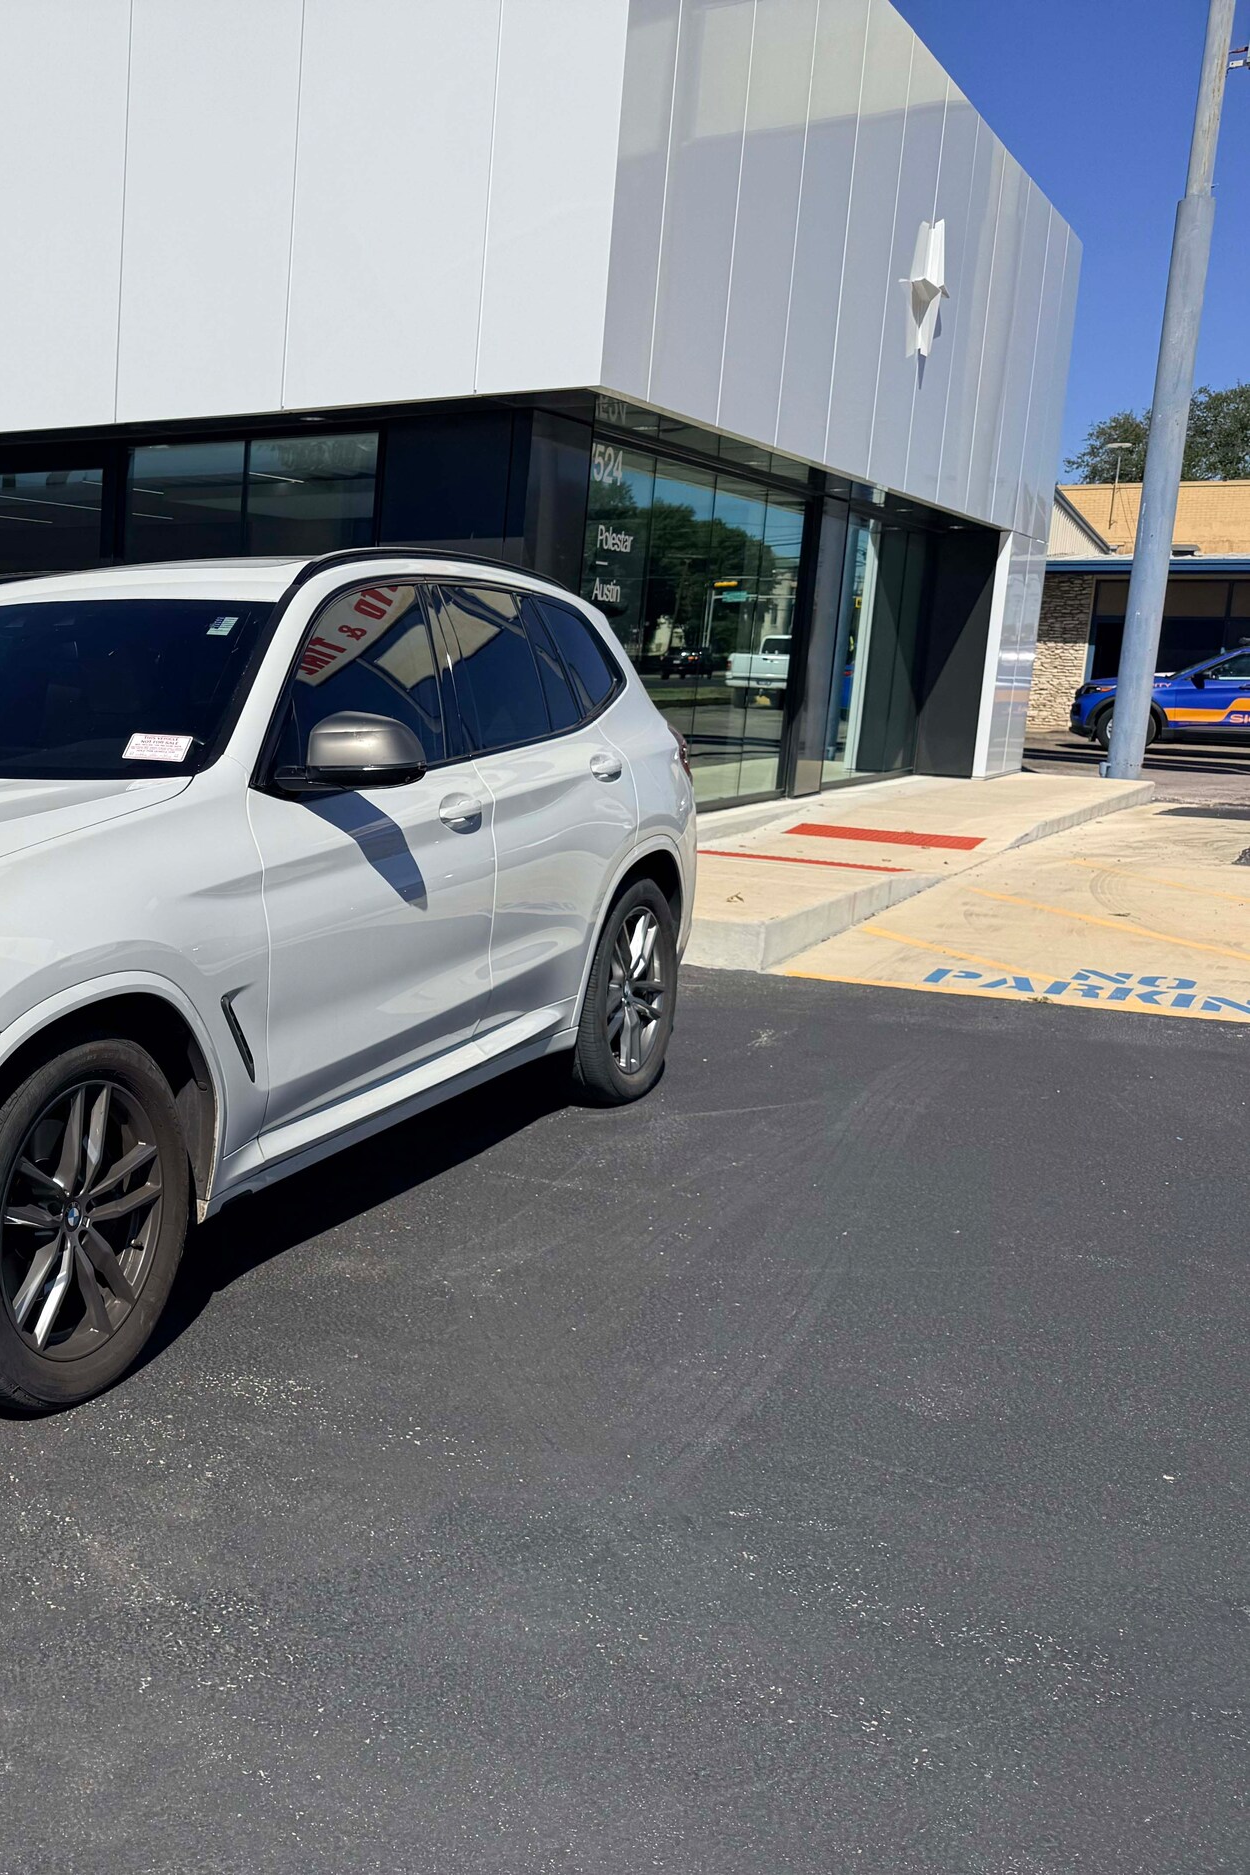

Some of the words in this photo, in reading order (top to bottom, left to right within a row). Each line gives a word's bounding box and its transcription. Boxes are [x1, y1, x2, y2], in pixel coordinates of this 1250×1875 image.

[597, 524, 634, 553] Polestar
[591, 577, 621, 602] Austin
[1230, 713, 1250, 724] SI
[1071, 968, 1197, 990] NO
